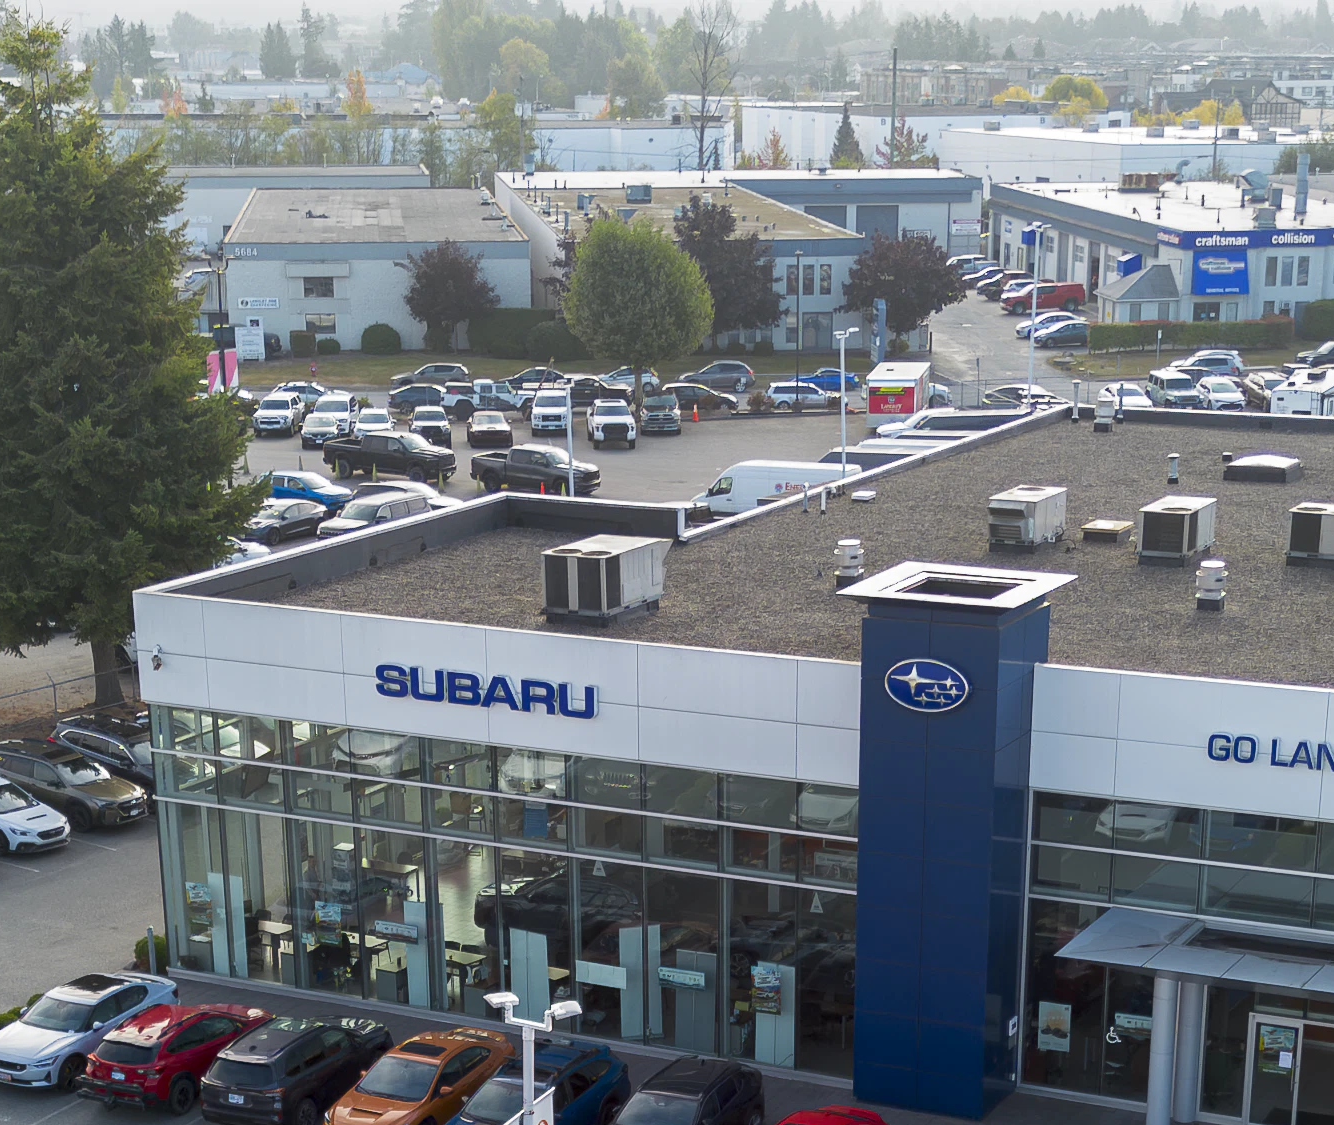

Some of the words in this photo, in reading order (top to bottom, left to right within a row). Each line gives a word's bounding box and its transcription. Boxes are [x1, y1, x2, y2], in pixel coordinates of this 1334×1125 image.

[1195, 234, 1249, 247] craftsman
[1271, 232, 1316, 245] collision
[375, 663, 598, 720] SUBARU
[1207, 733, 1258, 764] GO
